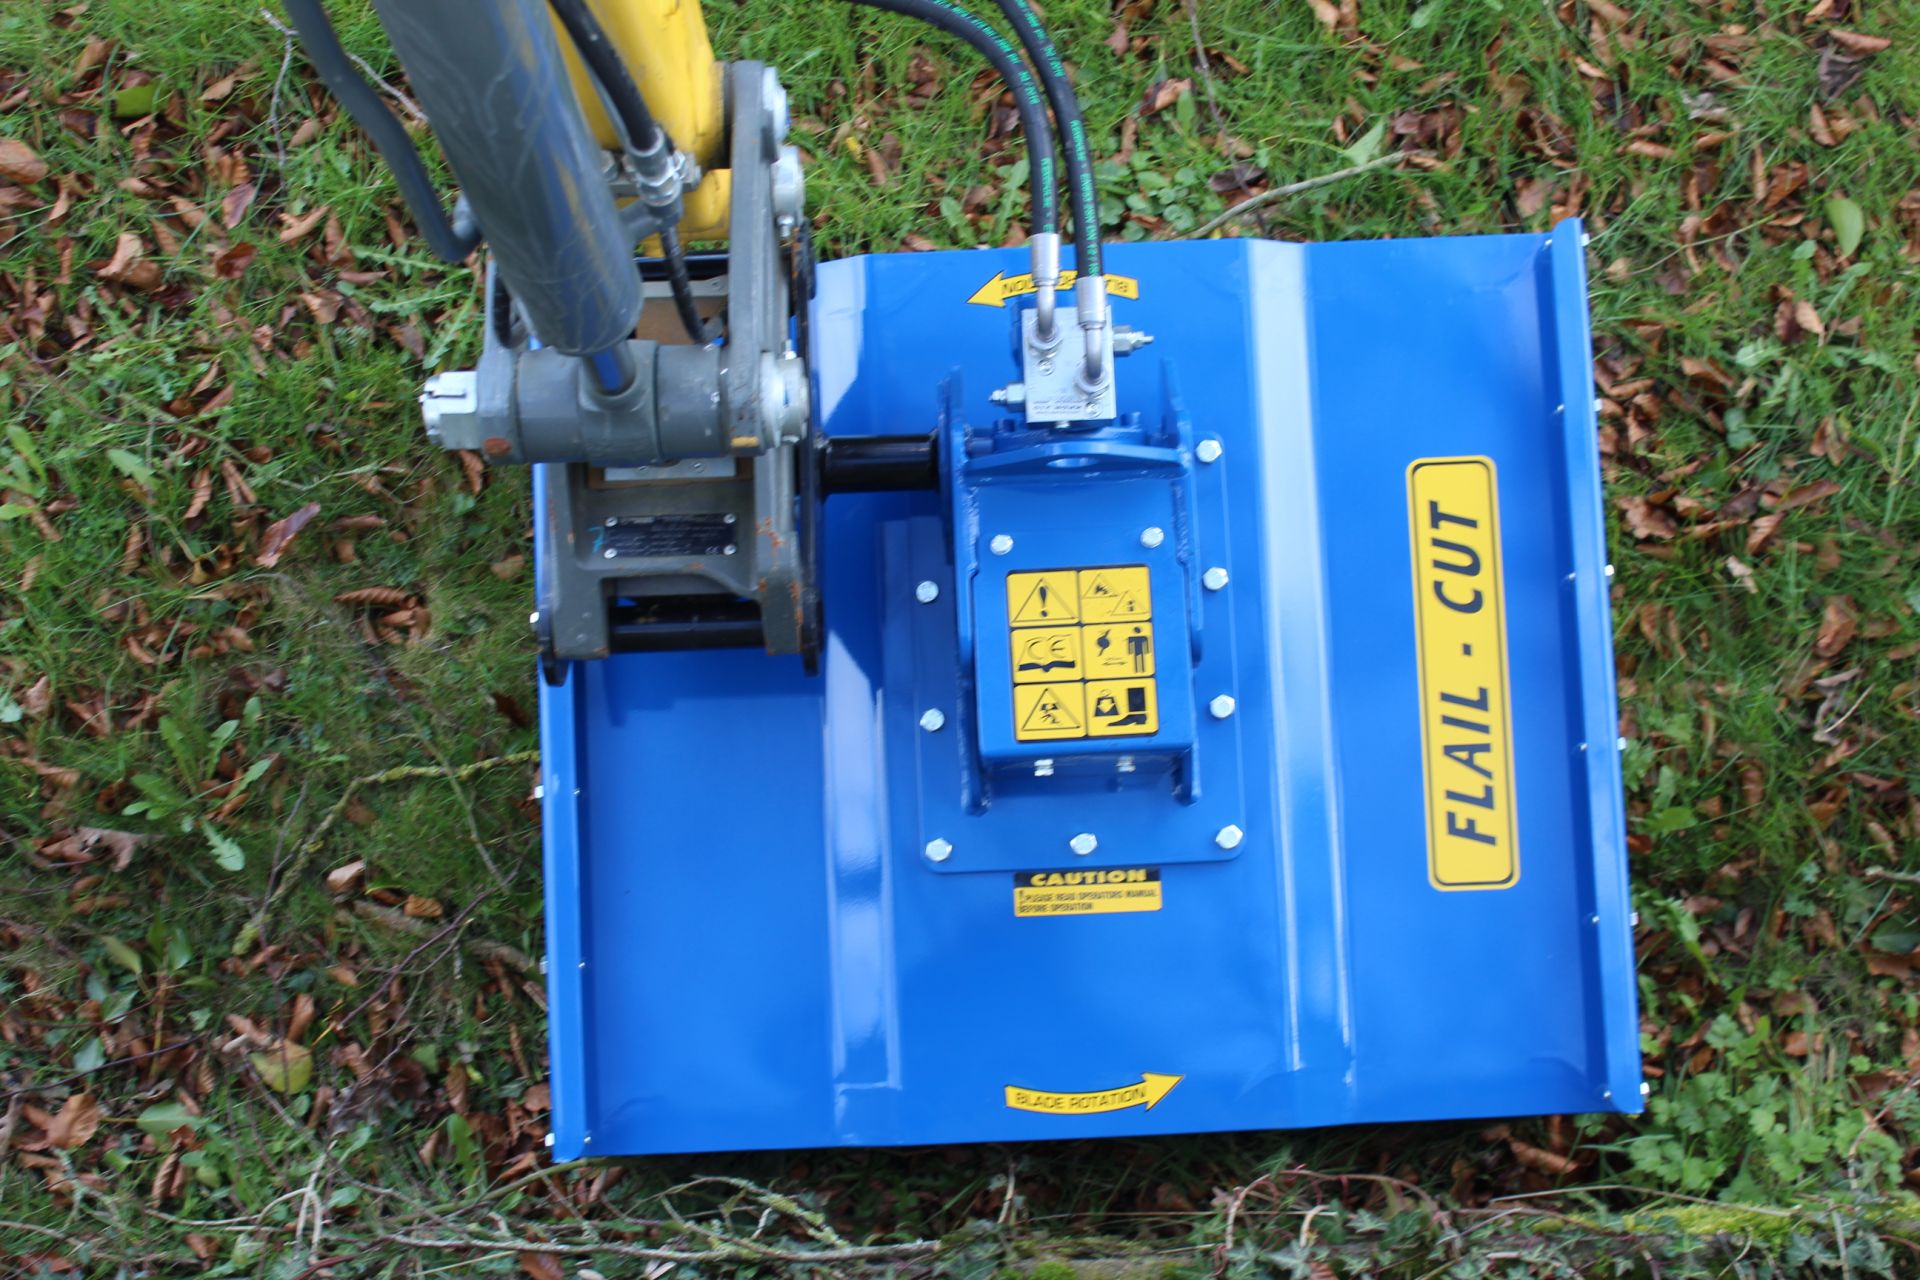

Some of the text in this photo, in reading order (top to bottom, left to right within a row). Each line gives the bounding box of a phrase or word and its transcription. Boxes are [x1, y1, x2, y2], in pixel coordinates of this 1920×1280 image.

[1428, 500, 1485, 614] CUT
[1439, 686, 1497, 846] FLAIL
[1030, 869, 1147, 887] CAUTION
[1126, 889, 1156, 899] MANUAL
[1015, 1086, 1147, 1109] BLADE ROTATION
